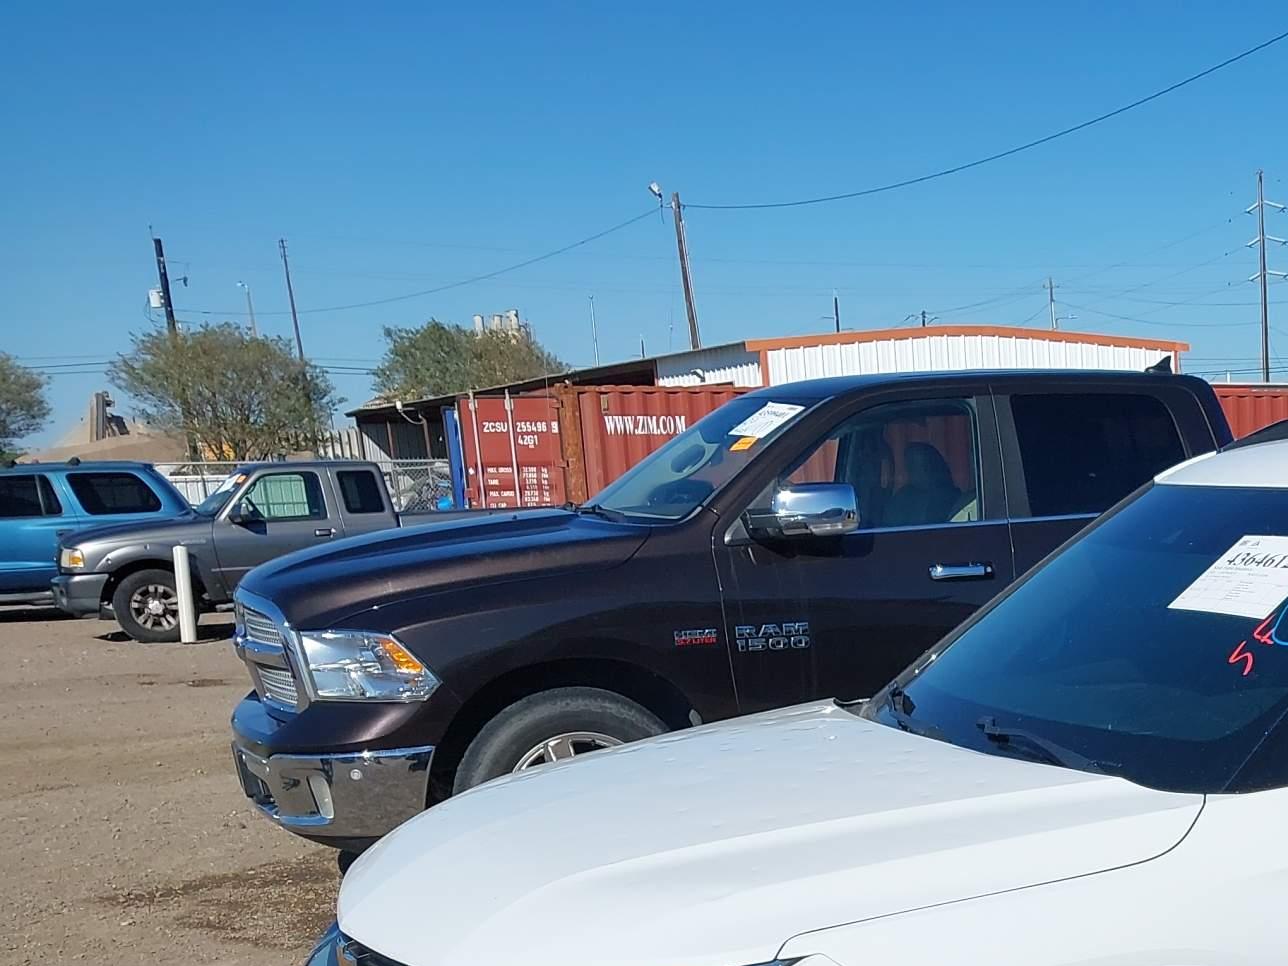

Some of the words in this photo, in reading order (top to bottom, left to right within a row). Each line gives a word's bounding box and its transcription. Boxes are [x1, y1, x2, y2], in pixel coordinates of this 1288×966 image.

[482, 421, 508, 433] ZCSU
[516, 421, 547, 433] 255496
[603, 415, 686, 435] WWW.ZIM.COM
[518, 435, 538, 446] 42G1
[735, 622, 809, 638] RAM
[736, 636, 810, 652] 1500
